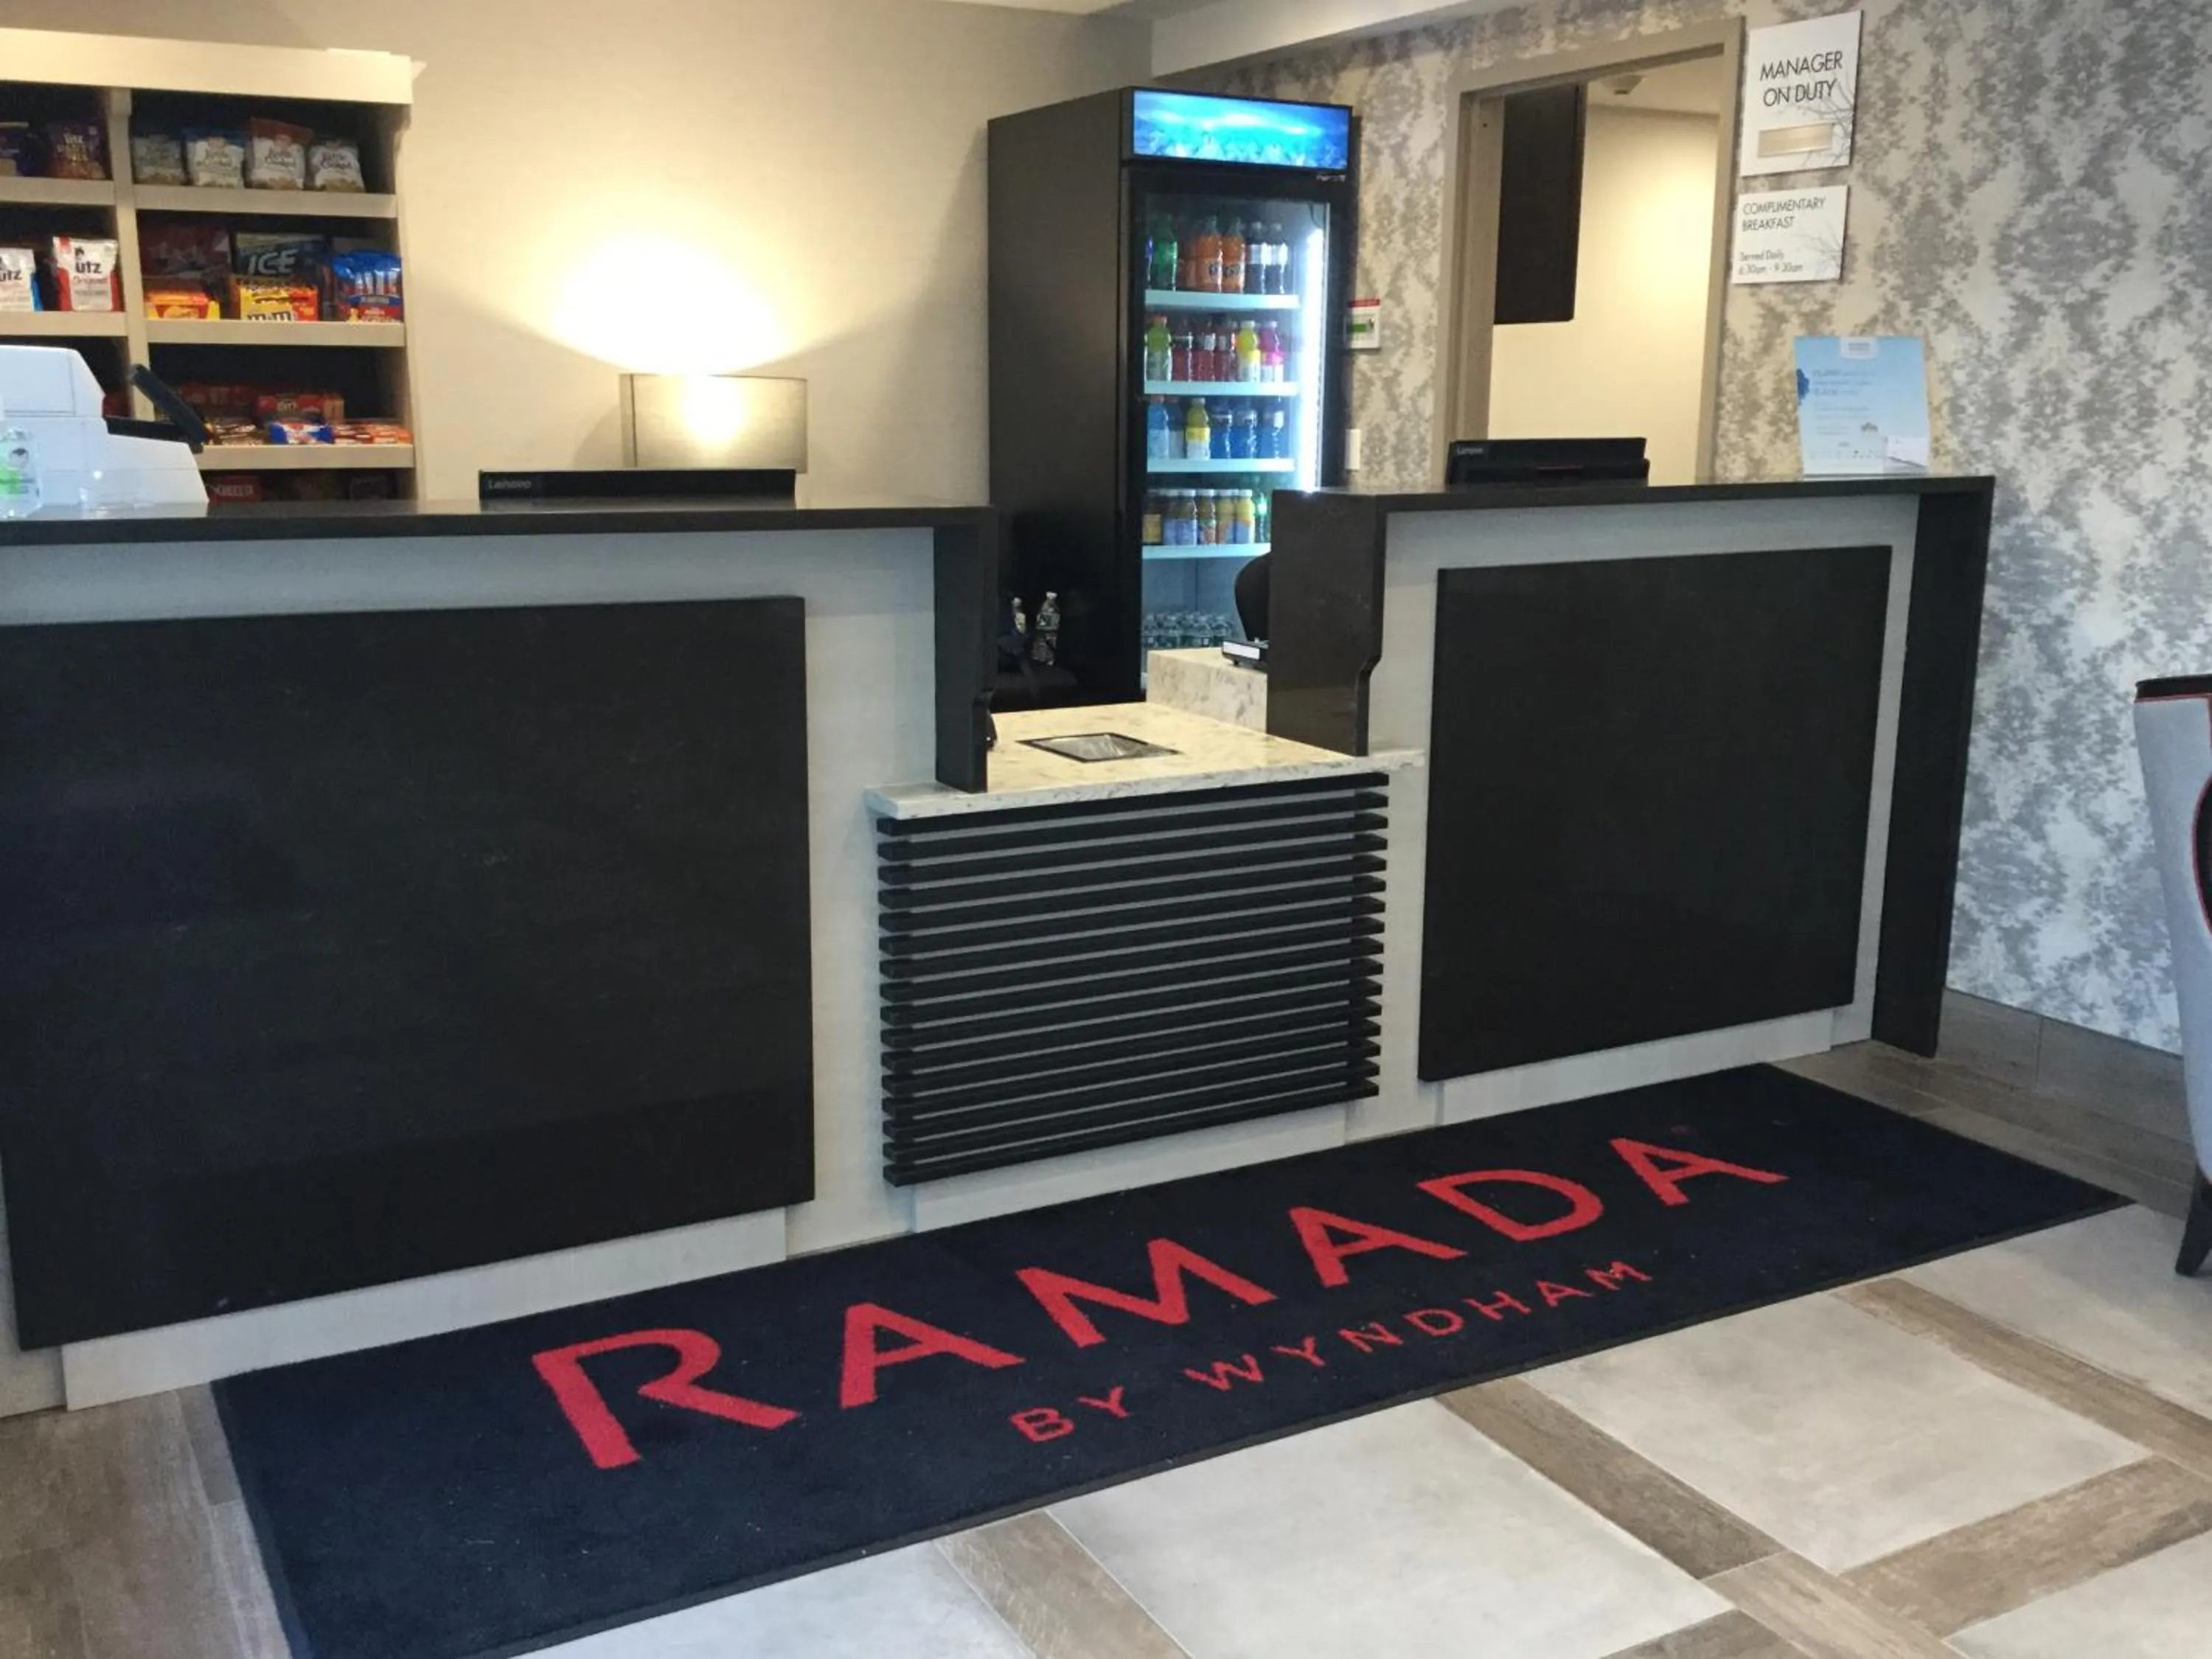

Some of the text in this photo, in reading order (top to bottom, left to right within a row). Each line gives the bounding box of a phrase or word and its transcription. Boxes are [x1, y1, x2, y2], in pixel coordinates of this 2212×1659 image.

[1760, 50, 1843, 81] MANAGER
[1763, 78, 1837, 107] ON DUTY
[1742, 196, 1826, 215] COMPLIMENTARY
[1742, 216, 1795, 232] BREAKFAST
[248, 248, 299, 275] ICE
[487, 479, 532, 490] Lenovo
[532, 1138, 1788, 1470] RAMADA
[1010, 1261, 1652, 1442] BY WYNDHAM
